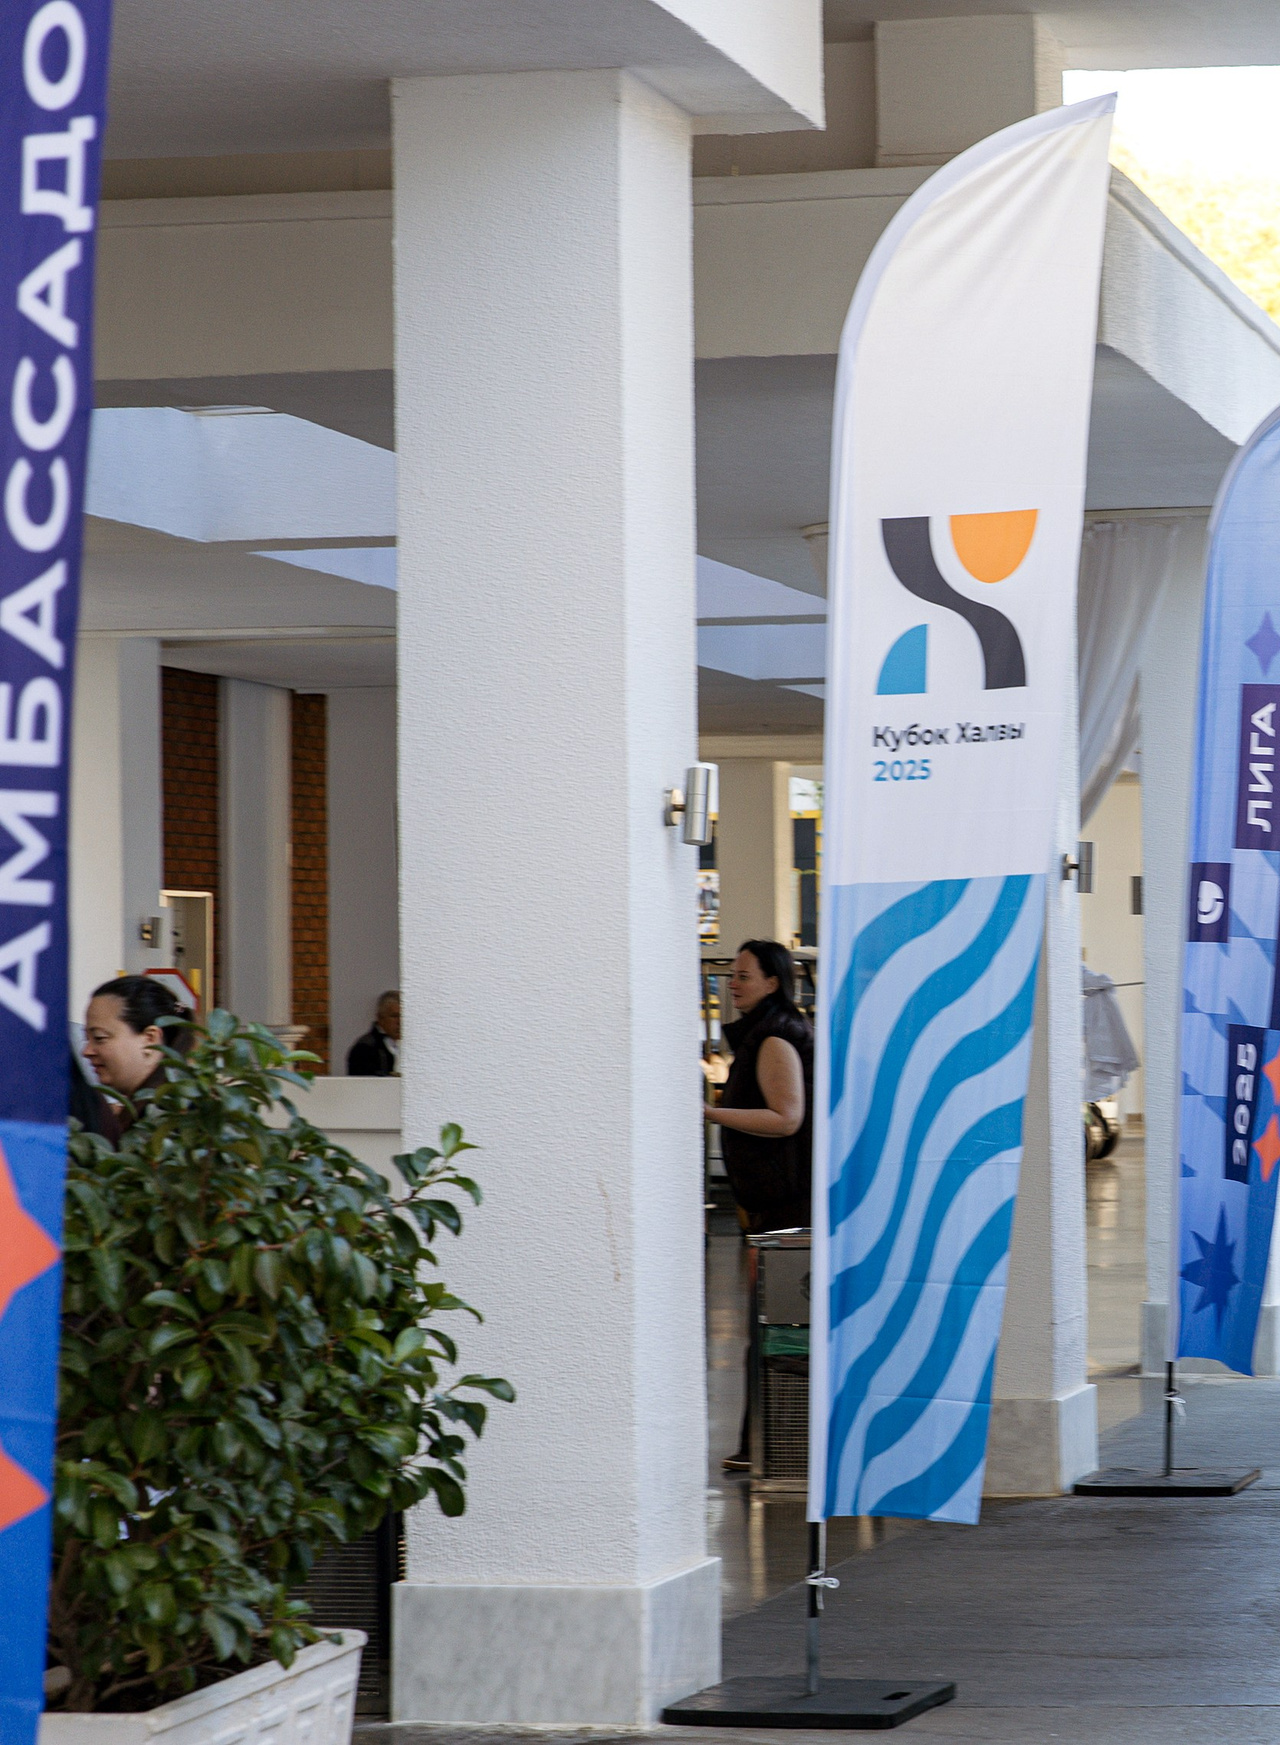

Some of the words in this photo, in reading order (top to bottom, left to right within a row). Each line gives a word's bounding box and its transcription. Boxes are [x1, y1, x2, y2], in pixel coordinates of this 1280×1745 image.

[873, 723, 950, 752] Кубок
[955, 722, 1025, 744] Халвы
[873, 759, 931, 781] 2025
[1246, 702, 1277, 832] ЛИГА
[1232, 1043, 1257, 1166] 2025
